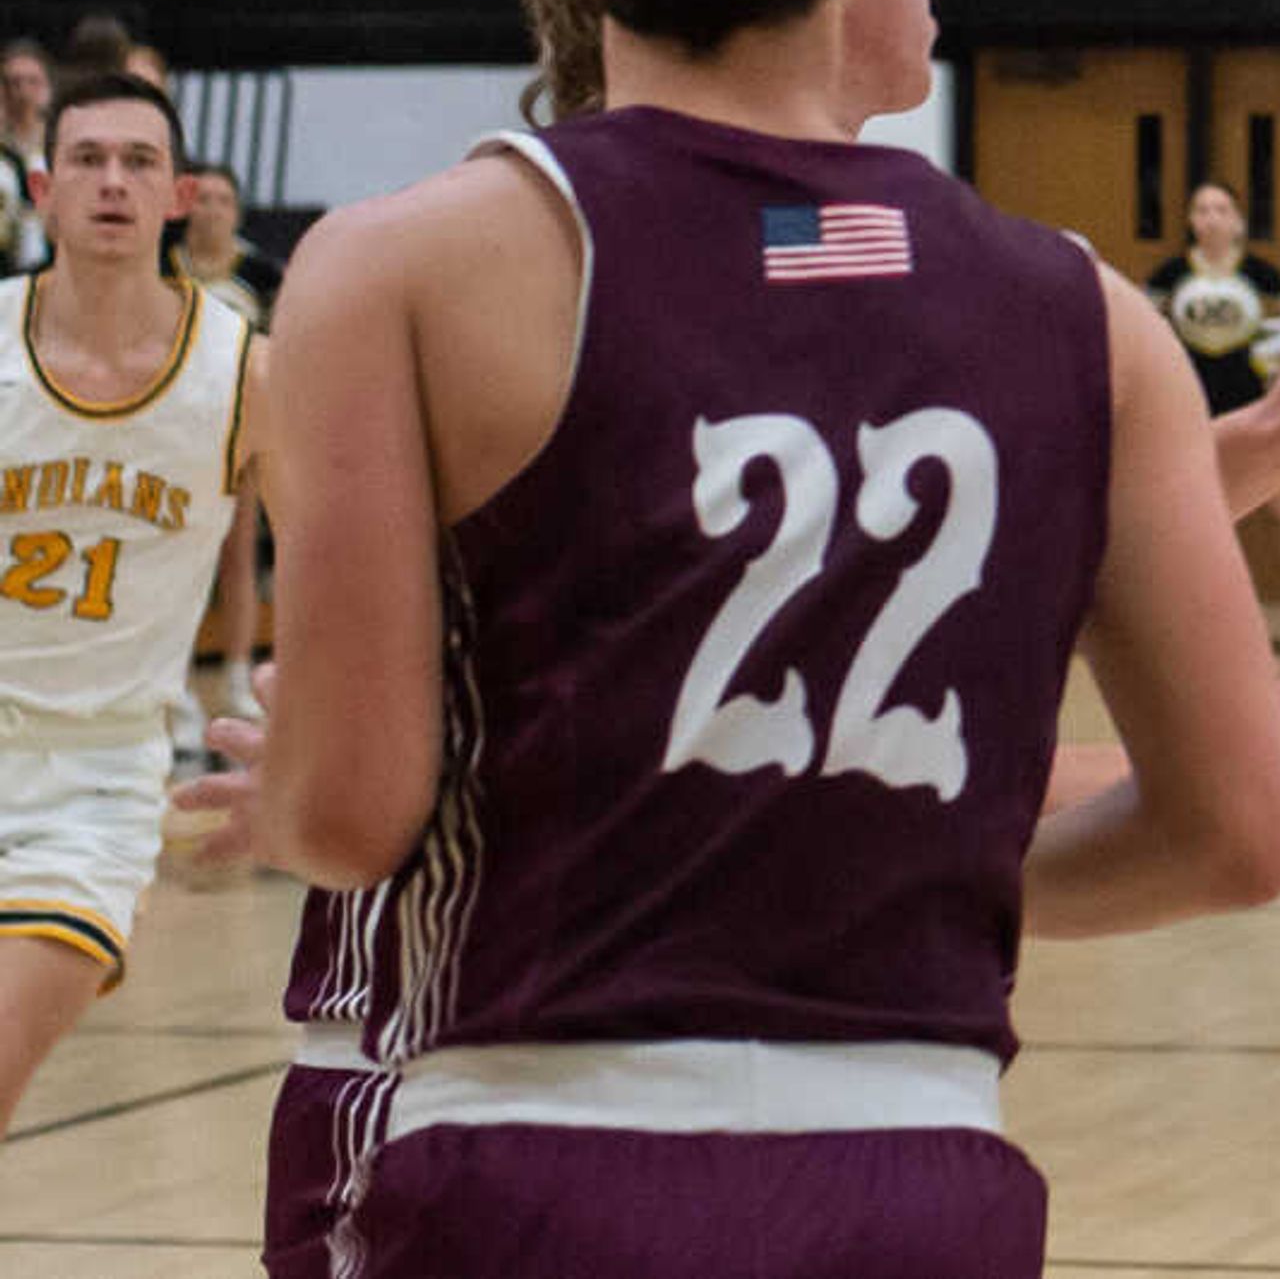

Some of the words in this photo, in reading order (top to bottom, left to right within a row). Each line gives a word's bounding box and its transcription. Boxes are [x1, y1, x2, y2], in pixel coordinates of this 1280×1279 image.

[0, 457, 192, 532] NDIANS
[0, 529, 122, 622] 21
[661, 406, 999, 804] 22
